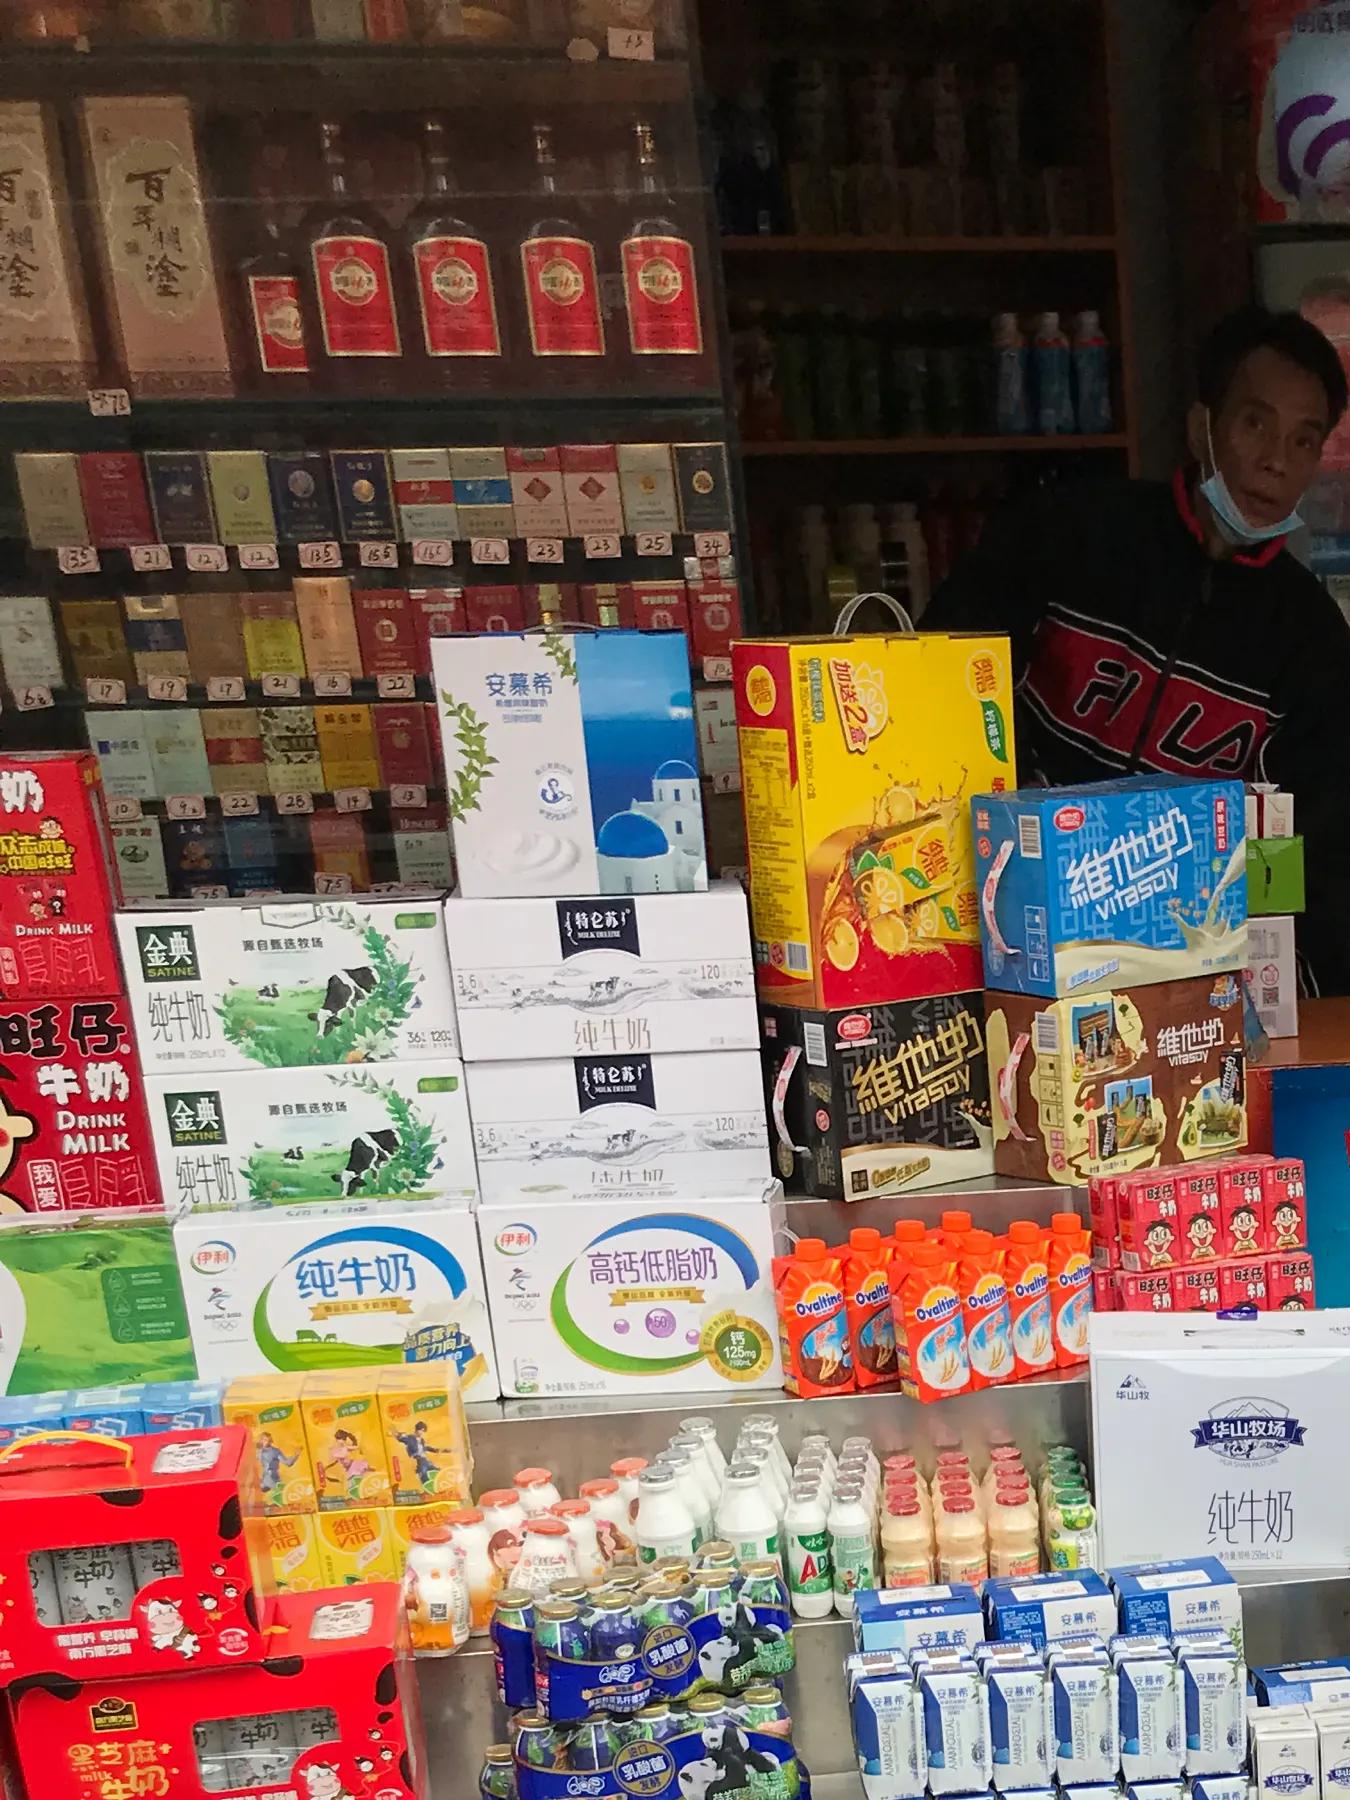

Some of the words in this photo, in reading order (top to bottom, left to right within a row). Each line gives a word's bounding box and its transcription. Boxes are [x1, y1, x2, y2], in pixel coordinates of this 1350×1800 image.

[485, 672, 553, 697] 安慕希
[1073, 659, 1257, 773] FILA
[1096, 863, 1179, 920] vitasoy
[575, 910, 619, 929] 特仑苏
[15, 923, 55, 937] DRINK
[59, 922, 94, 936] MILK
[143, 931, 193, 967] 金典
[147, 967, 196, 978] SATINE
[700, 964, 721, 979] 120
[148, 990, 212, 1043] 纯牛奶
[0, 1004, 128, 1058] 旺仔
[574, 1017, 651, 1051] 纯牛奶
[1168, 1049, 1209, 1067] vitasoy
[38, 1062, 130, 1104] 牛奶
[592, 1066, 636, 1084] 特仑苏
[884, 1065, 971, 1125] vitasoy
[56, 1110, 127, 1131] DRINK
[171, 1096, 221, 1132] 金典
[715, 1117, 735, 1131] 120
[62, 1132, 130, 1155] MILK
[175, 1131, 222, 1143] SATINE
[175, 1154, 238, 1203] 纯牛奶
[1232, 1169, 1260, 1187] 旺仔
[1276, 1166, 1301, 1181] 旺仔
[1147, 1183, 1175, 1200] 旺仔
[1190, 1176, 1217, 1194] 旺仔
[1287, 1181, 1304, 1199] 牛奶
[1201, 1192, 1219, 1210] 牛奶
[1244, 1186, 1261, 1204] 牛奶
[1159, 1199, 1177, 1217] 牛奶
[499, 1233, 531, 1247] 伊利
[195, 1248, 229, 1266] 伊利
[587, 1247, 719, 1285] 高钙低脂奶
[295, 1253, 416, 1300] 纯牛奶
[1234, 1266, 1264, 1282] 旺仔
[1282, 1260, 1310, 1276] 旺仔
[1139, 1277, 1169, 1292] 旺仔
[1187, 1270, 1216, 1287] 旺仔
[1294, 1276, 1313, 1293] 牛奶
[1152, 1292, 1172, 1309] 牛奶
[1200, 1287, 1219, 1305] 牛奶
[1246, 1283, 1266, 1300] 牛奶
[796, 1291, 843, 1316] Ovaltine
[653, 1315, 668, 1329] 50
[729, 1331, 746, 1346] 钙
[723, 1345, 757, 1360] 125mg
[1116, 1390, 1150, 1401] 华山牧
[1211, 1419, 1287, 1439] 华山牧场
[1207, 1489, 1294, 1546] 纯牛奶
[74, 1560, 114, 1588] 牛奶
[1185, 1599, 1221, 1616] 安慕希
[1060, 1610, 1097, 1627] 安慕希
[917, 1628, 967, 1647] 安慕希
[649, 1638, 690, 1667] 乳酸菌
[1066, 1679, 1098, 1693] 安慕希
[1133, 1672, 1165, 1688] 安慕希
[1195, 1670, 1227, 1685] 安慕希
[937, 1685, 969, 1700] 安慕希
[1003, 1684, 1035, 1699] 安慕希
[872, 1694, 904, 1708] 安慕希
[67, 1739, 158, 1772] 黑芝麻
[80, 1770, 113, 1783] milk
[620, 1755, 668, 1781] 乳酸菌
